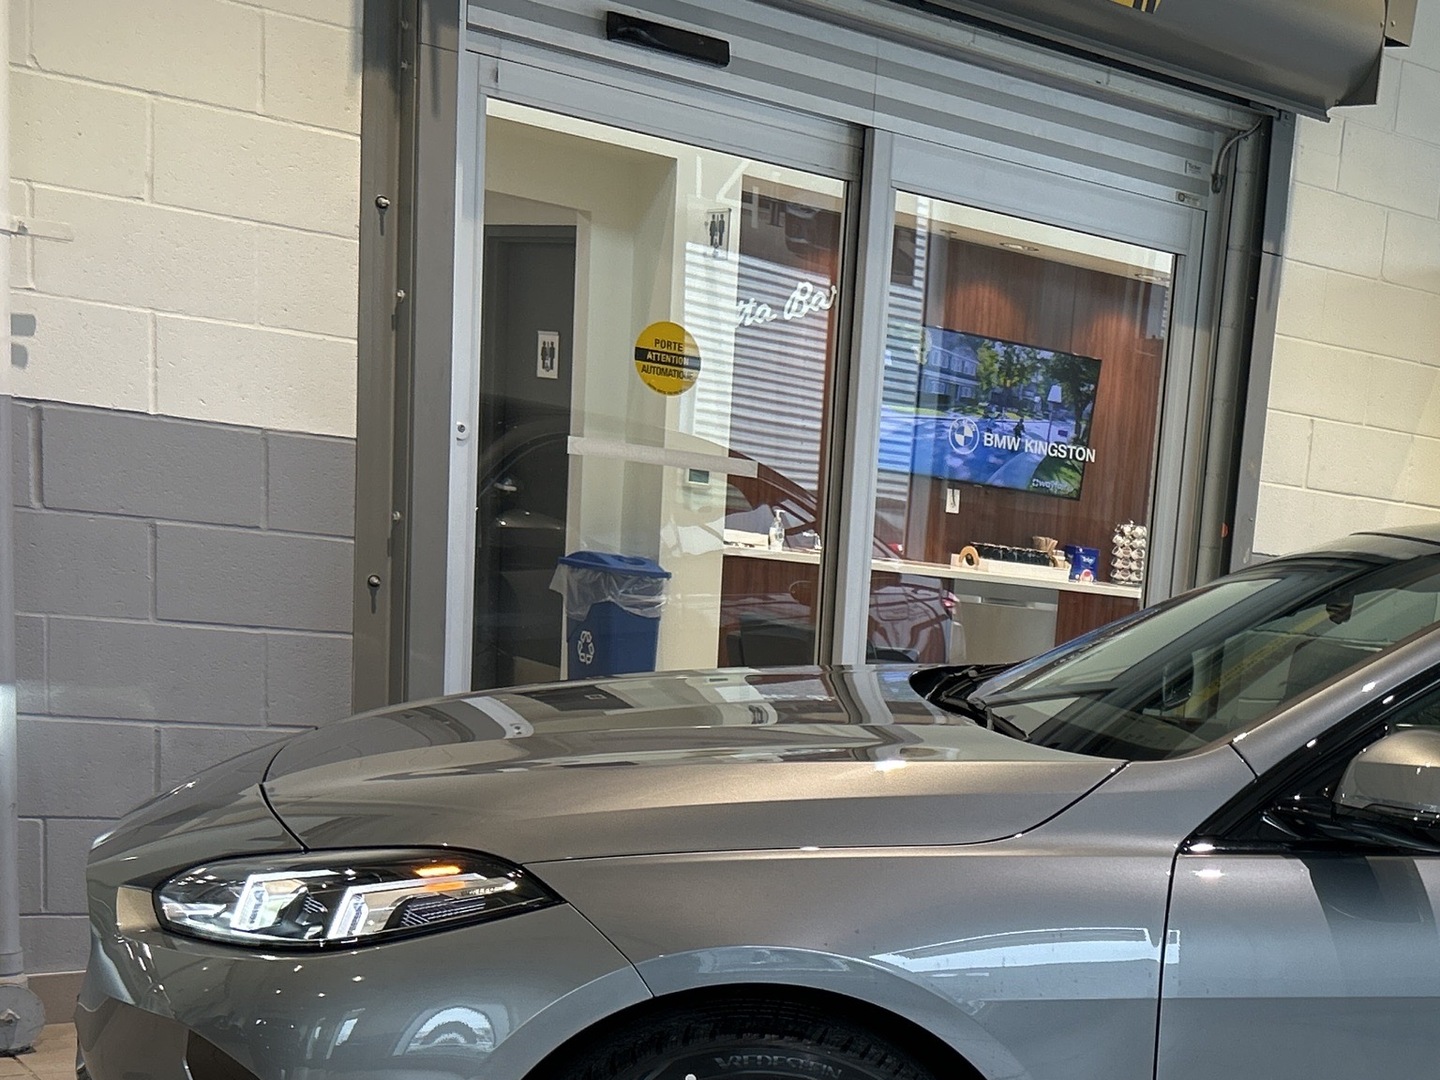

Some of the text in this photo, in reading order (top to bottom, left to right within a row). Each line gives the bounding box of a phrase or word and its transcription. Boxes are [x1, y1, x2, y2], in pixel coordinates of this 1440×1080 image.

[654, 338, 684, 352] PORTE
[646, 351, 690, 366] ATTENTION
[983, 431, 1096, 463] BMW KINGSTON
